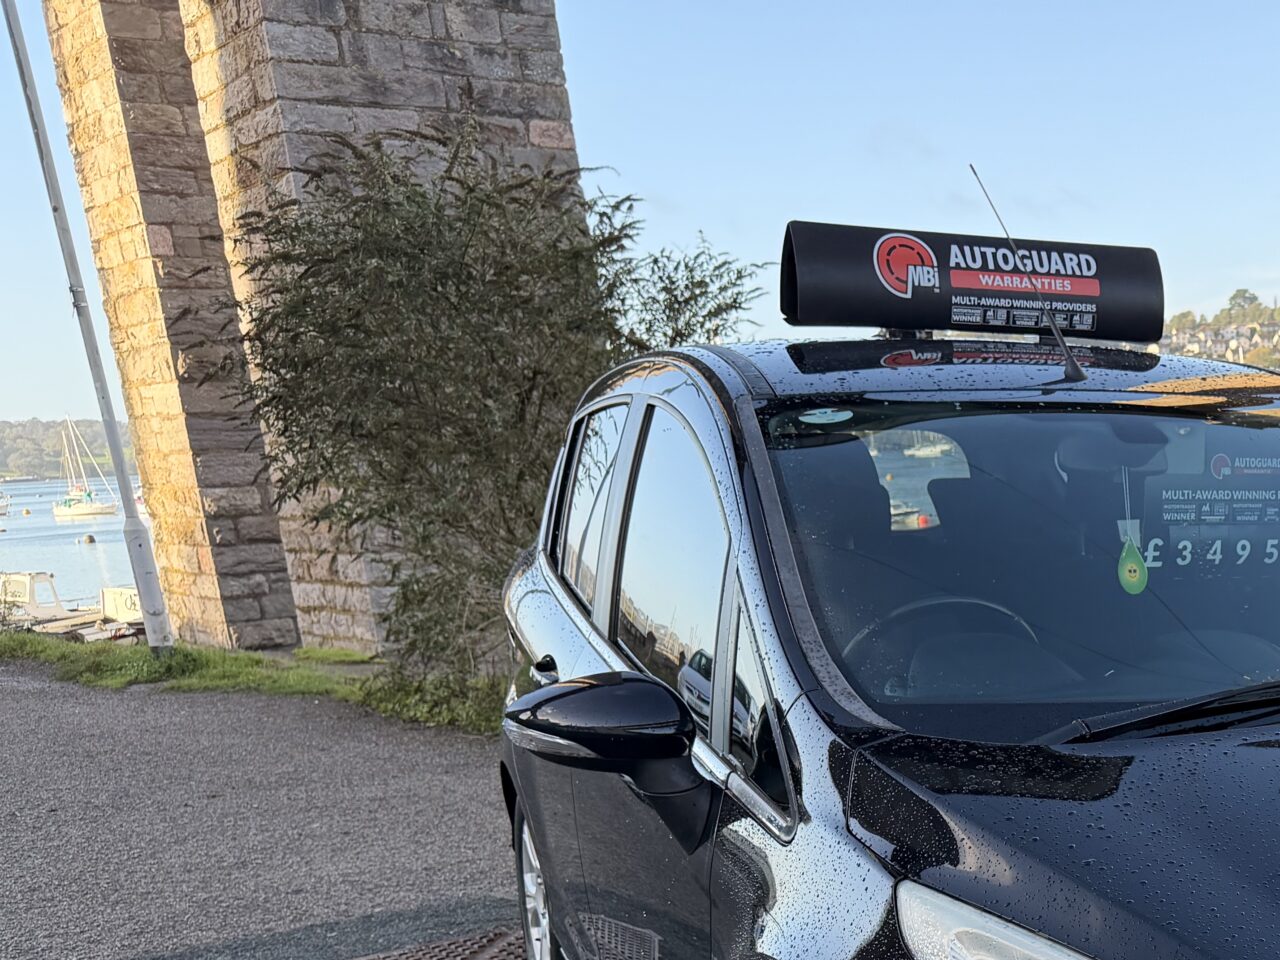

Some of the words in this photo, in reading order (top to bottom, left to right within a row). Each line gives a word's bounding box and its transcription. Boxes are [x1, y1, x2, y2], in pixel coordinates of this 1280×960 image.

[950, 244, 1098, 277] AUTOGUARD
[979, 274, 1072, 292] WARRANTIES
[951, 296, 1012, 307] MULTI-AWARD
[1012, 299, 1051, 310] WINNING
[1052, 301, 1097, 312] PROVIDERS
[1162, 489, 1232, 500] MULTI-AWARD
[1232, 489, 1276, 500] WINNING
[1163, 512, 1196, 521] WINNER
